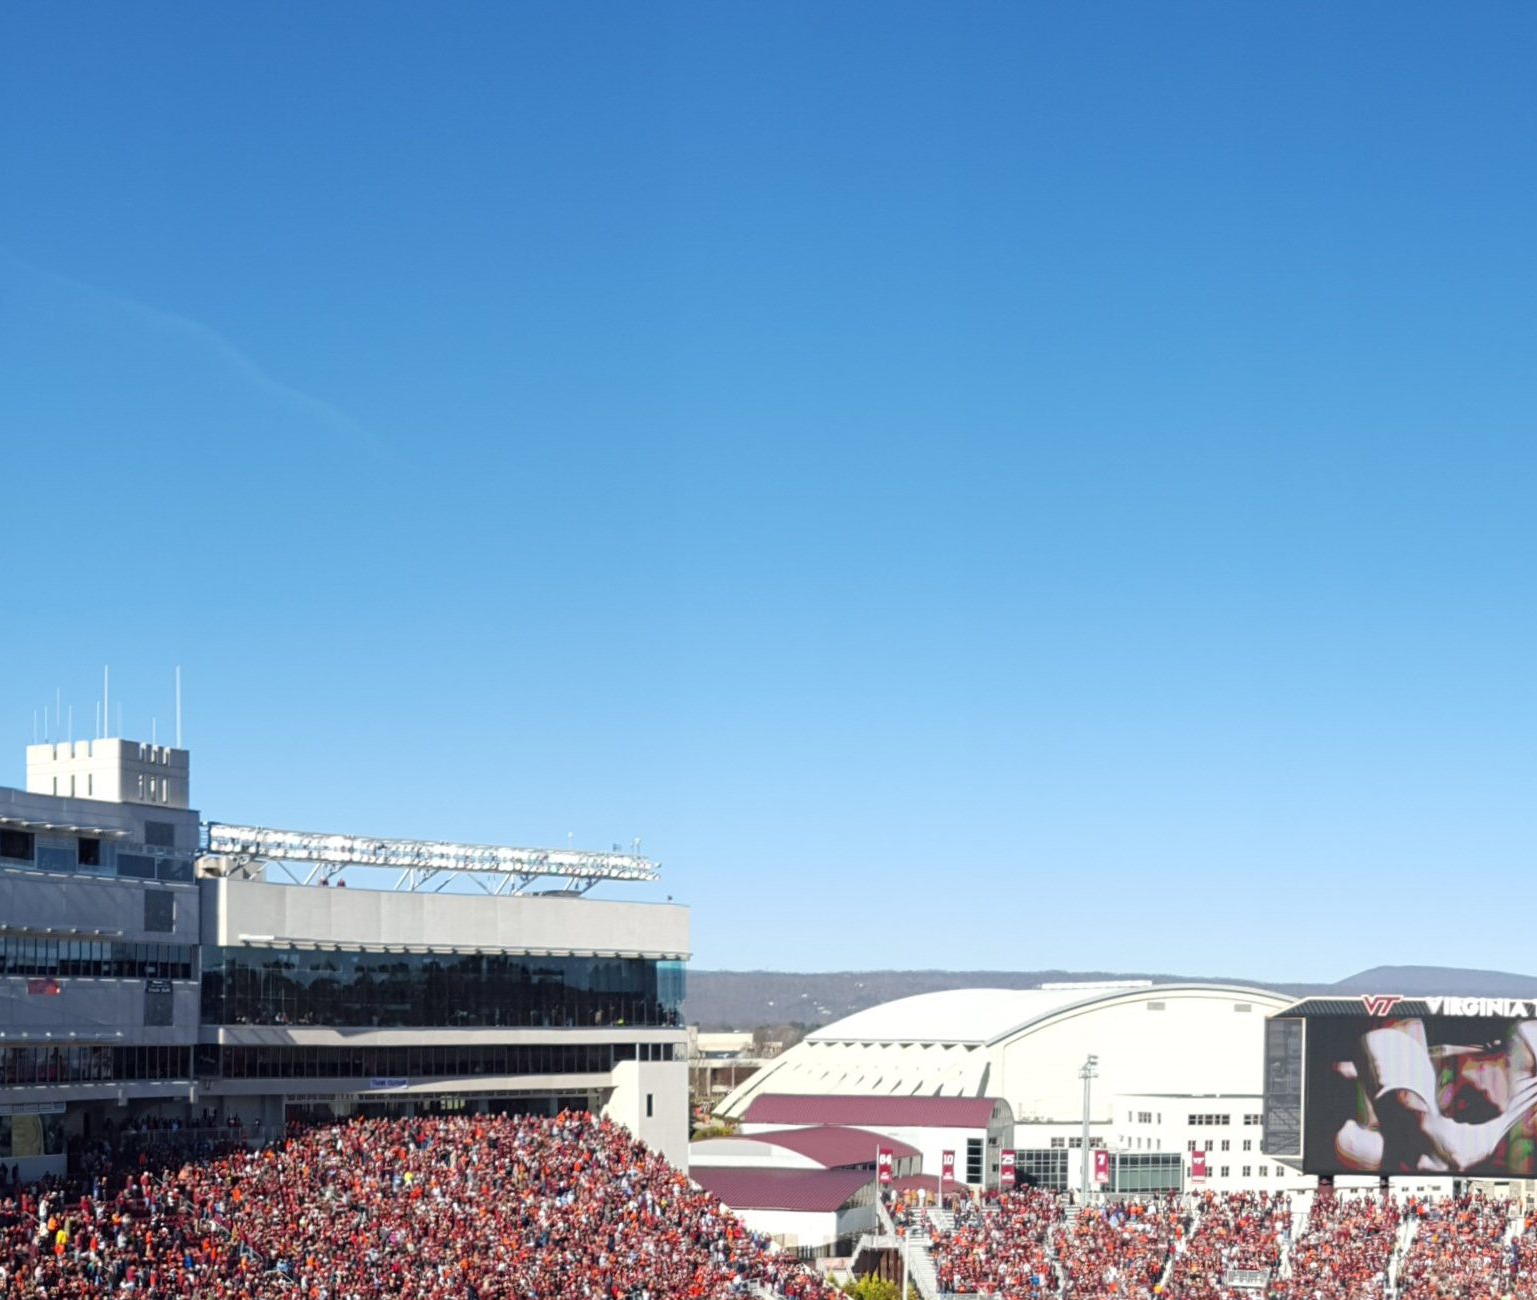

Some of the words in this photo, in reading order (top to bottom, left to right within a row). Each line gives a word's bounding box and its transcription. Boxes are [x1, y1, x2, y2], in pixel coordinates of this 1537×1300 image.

[1363, 995, 1403, 1016] VT
[1424, 997, 1529, 1018] VIRGINIA
[943, 1154, 953, 1165] 10
[1001, 1154, 1014, 1165] 25
[1097, 1154, 1106, 1165] 7
